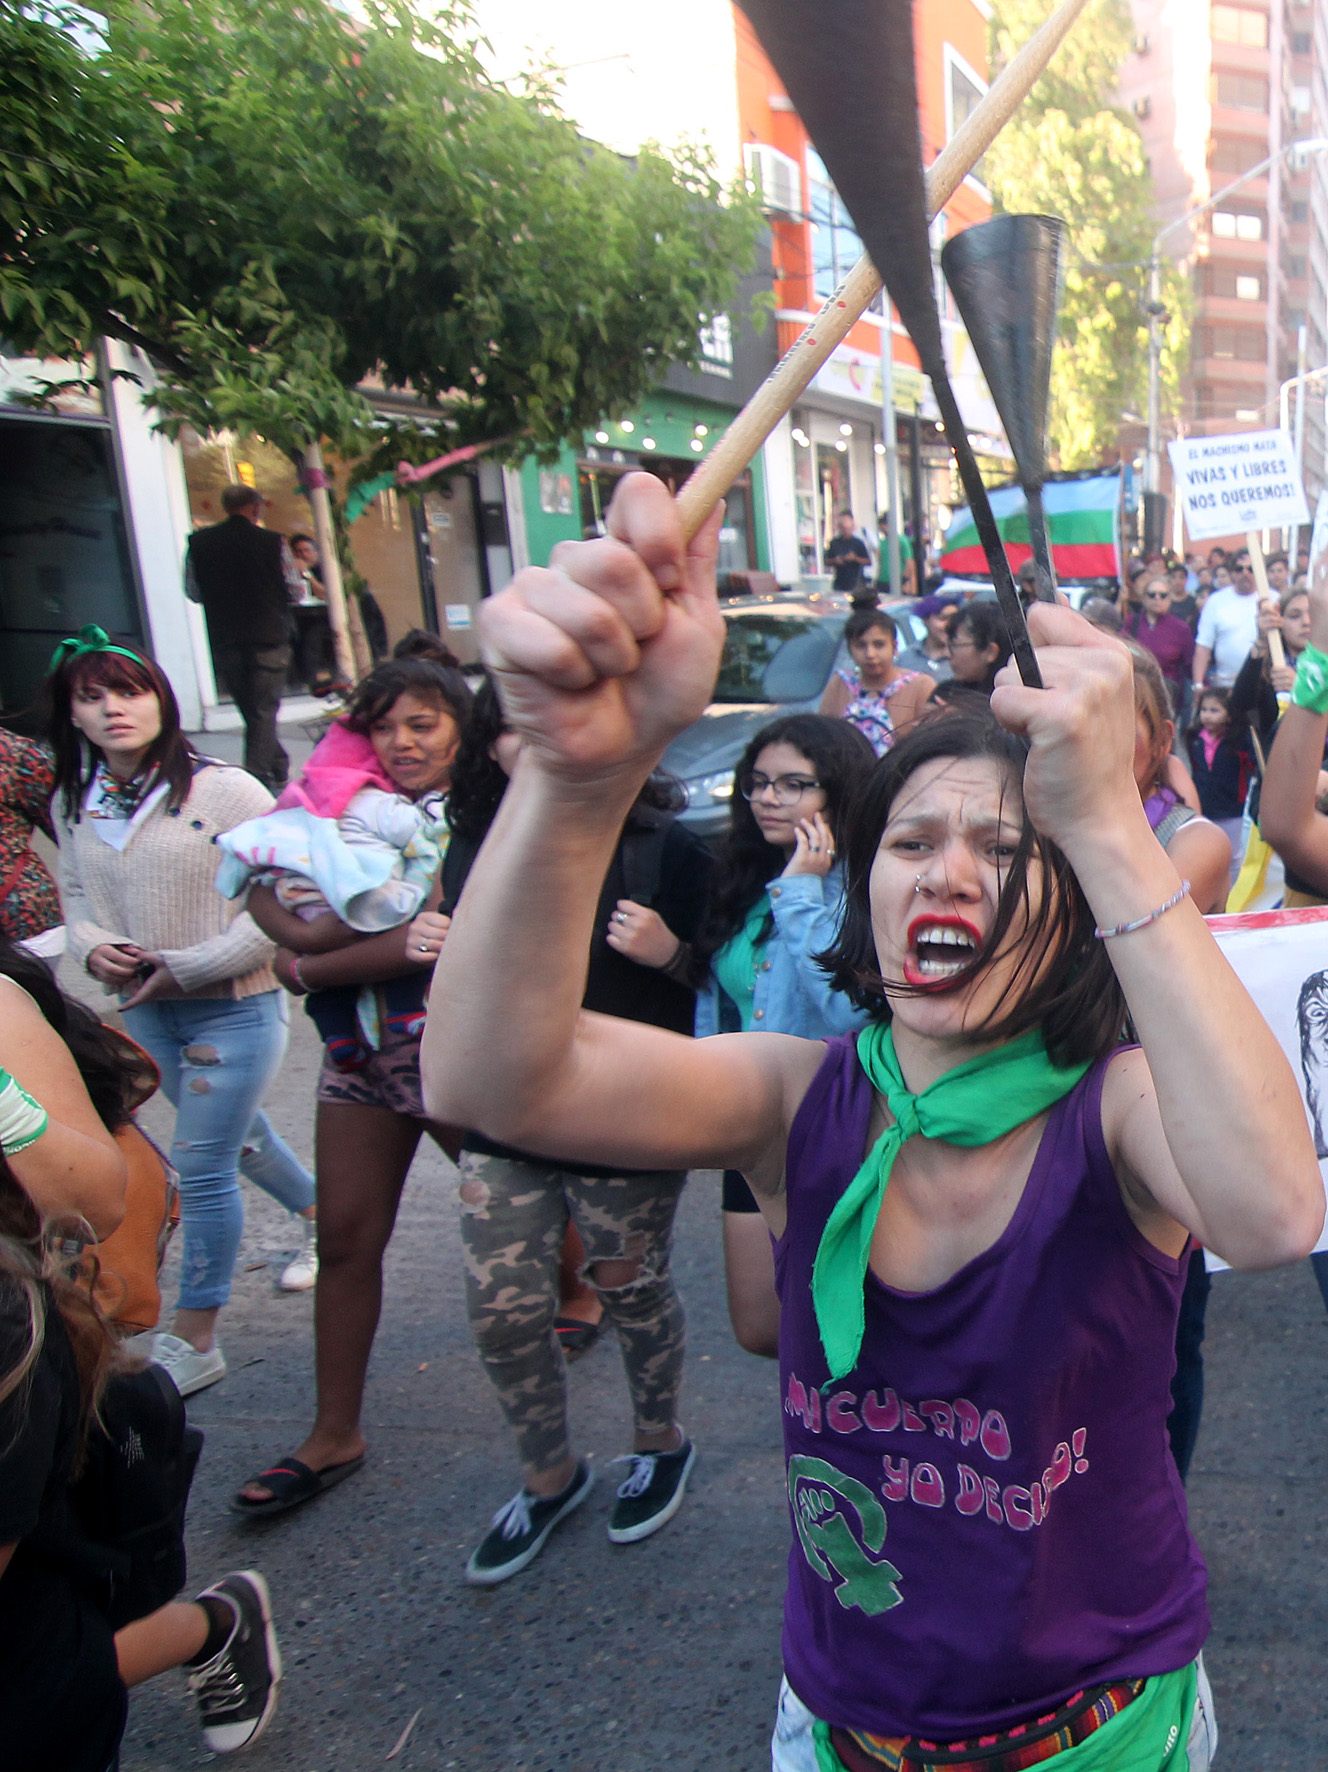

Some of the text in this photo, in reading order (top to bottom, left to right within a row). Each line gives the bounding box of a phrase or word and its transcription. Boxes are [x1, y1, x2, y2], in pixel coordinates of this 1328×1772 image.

[1188, 448, 1198, 460] EL
[1253, 440, 1277, 451] MATA
[1186, 460, 1287, 485] VIVAS Y LIBRES
[1188, 483, 1296, 511] NOS QUEREMOS!
[826, 1387, 1012, 1461] CUERPO
[881, 1454, 945, 1508] YO
